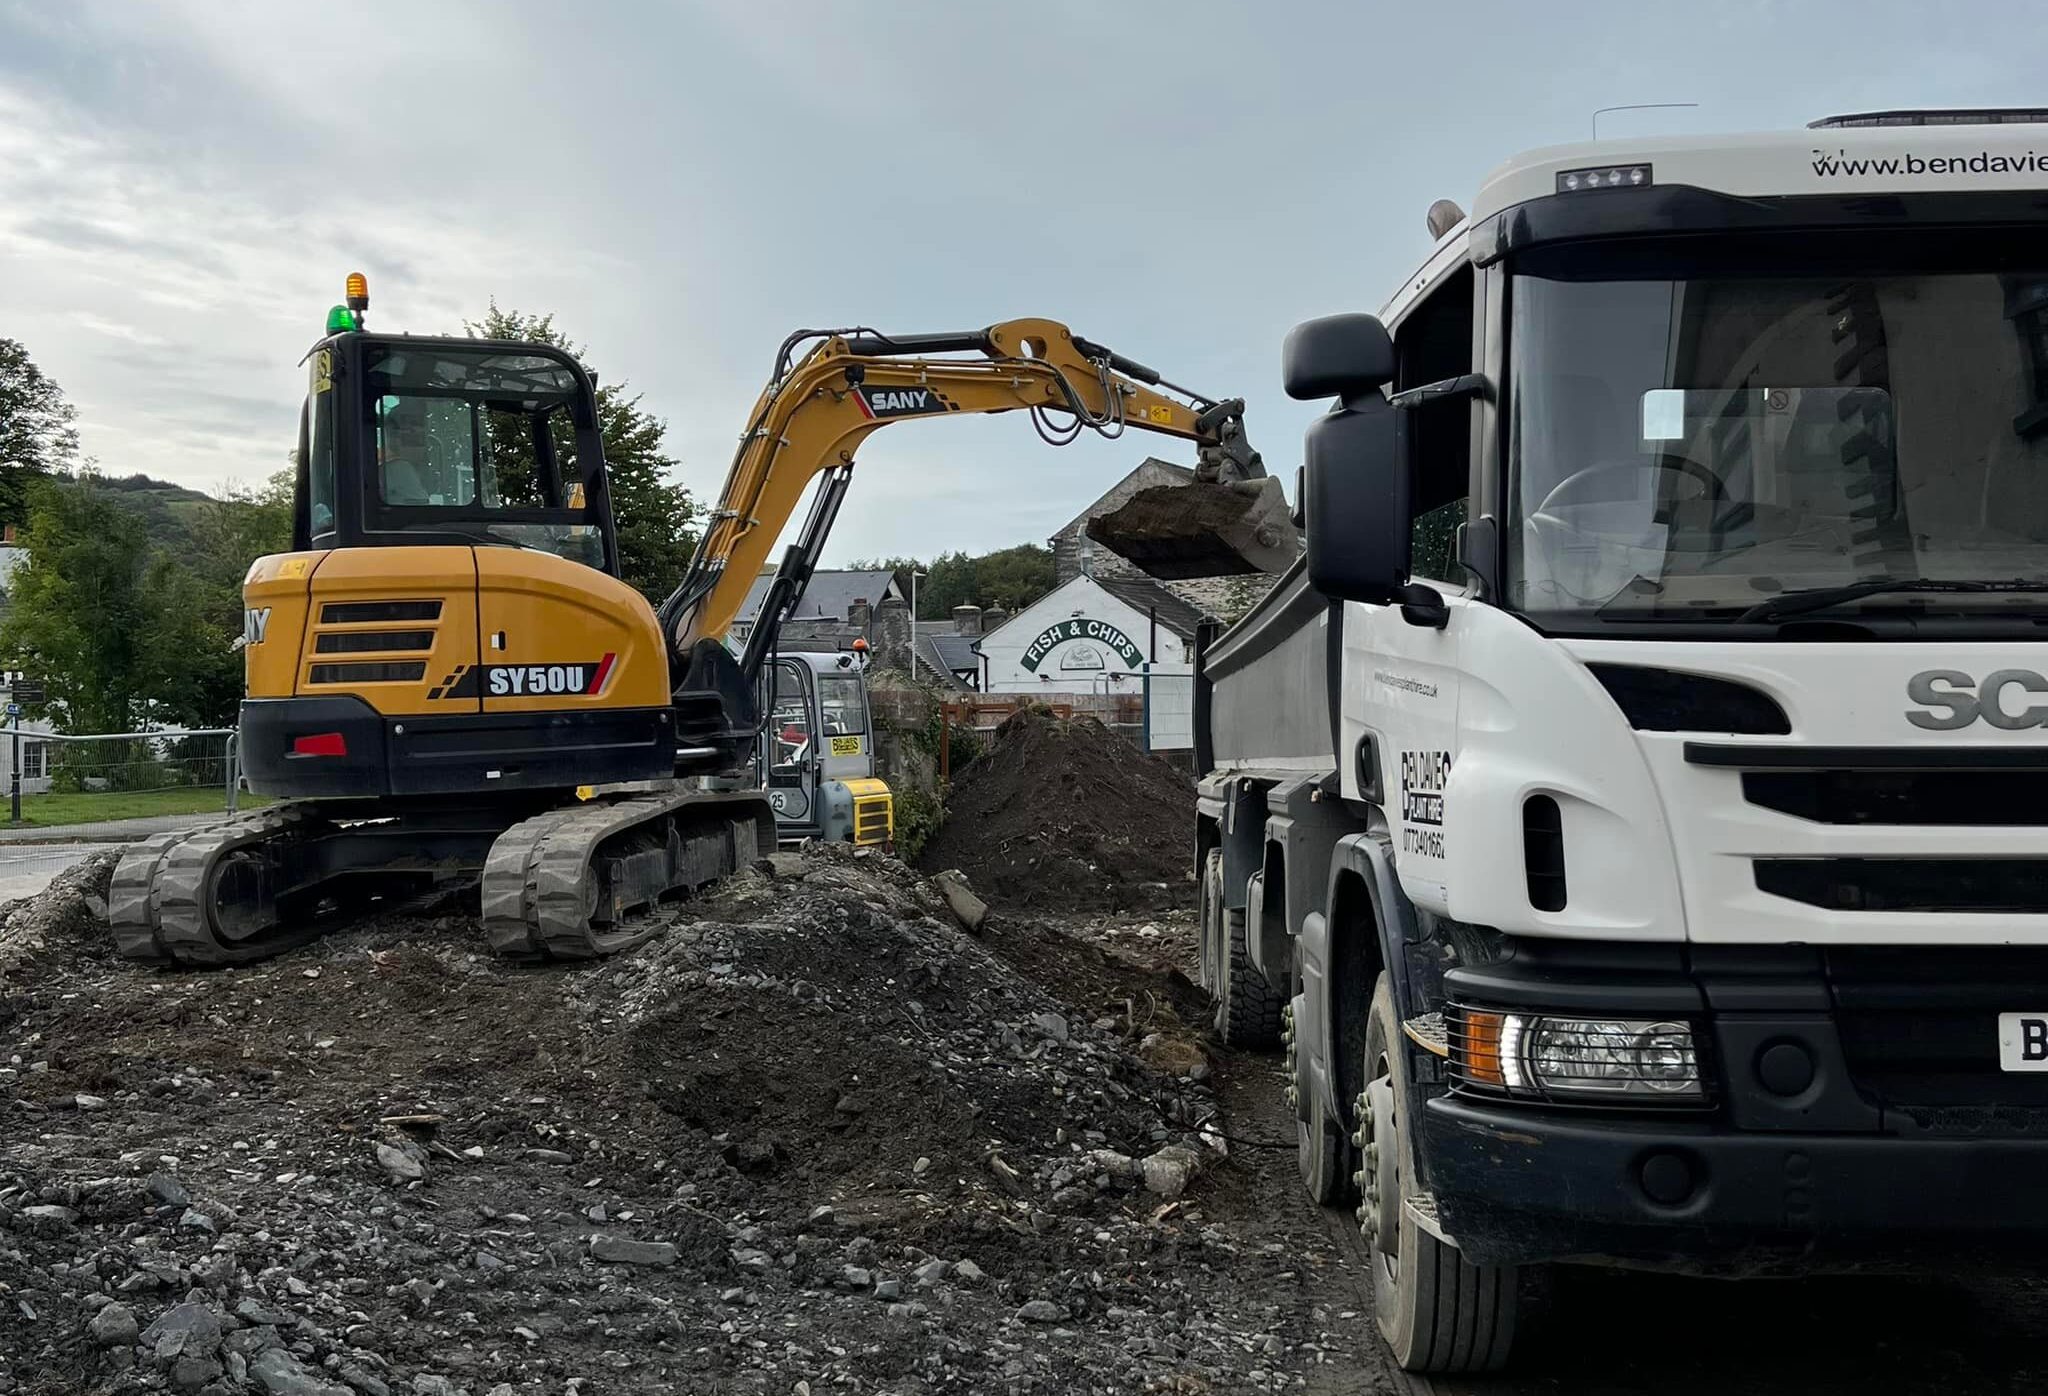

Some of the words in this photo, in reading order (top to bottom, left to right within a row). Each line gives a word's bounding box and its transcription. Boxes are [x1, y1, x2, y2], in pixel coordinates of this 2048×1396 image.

[871, 391, 928, 411] SANY
[1027, 626, 1063, 662] FISH
[1069, 621, 1081, 636] &
[1087, 621, 1135, 659] CHIPS
[489, 666, 584, 695] SY50U
[1904, 669, 2048, 730] SC
[771, 794, 784, 809] 25
[2020, 1019, 2048, 1061] B
